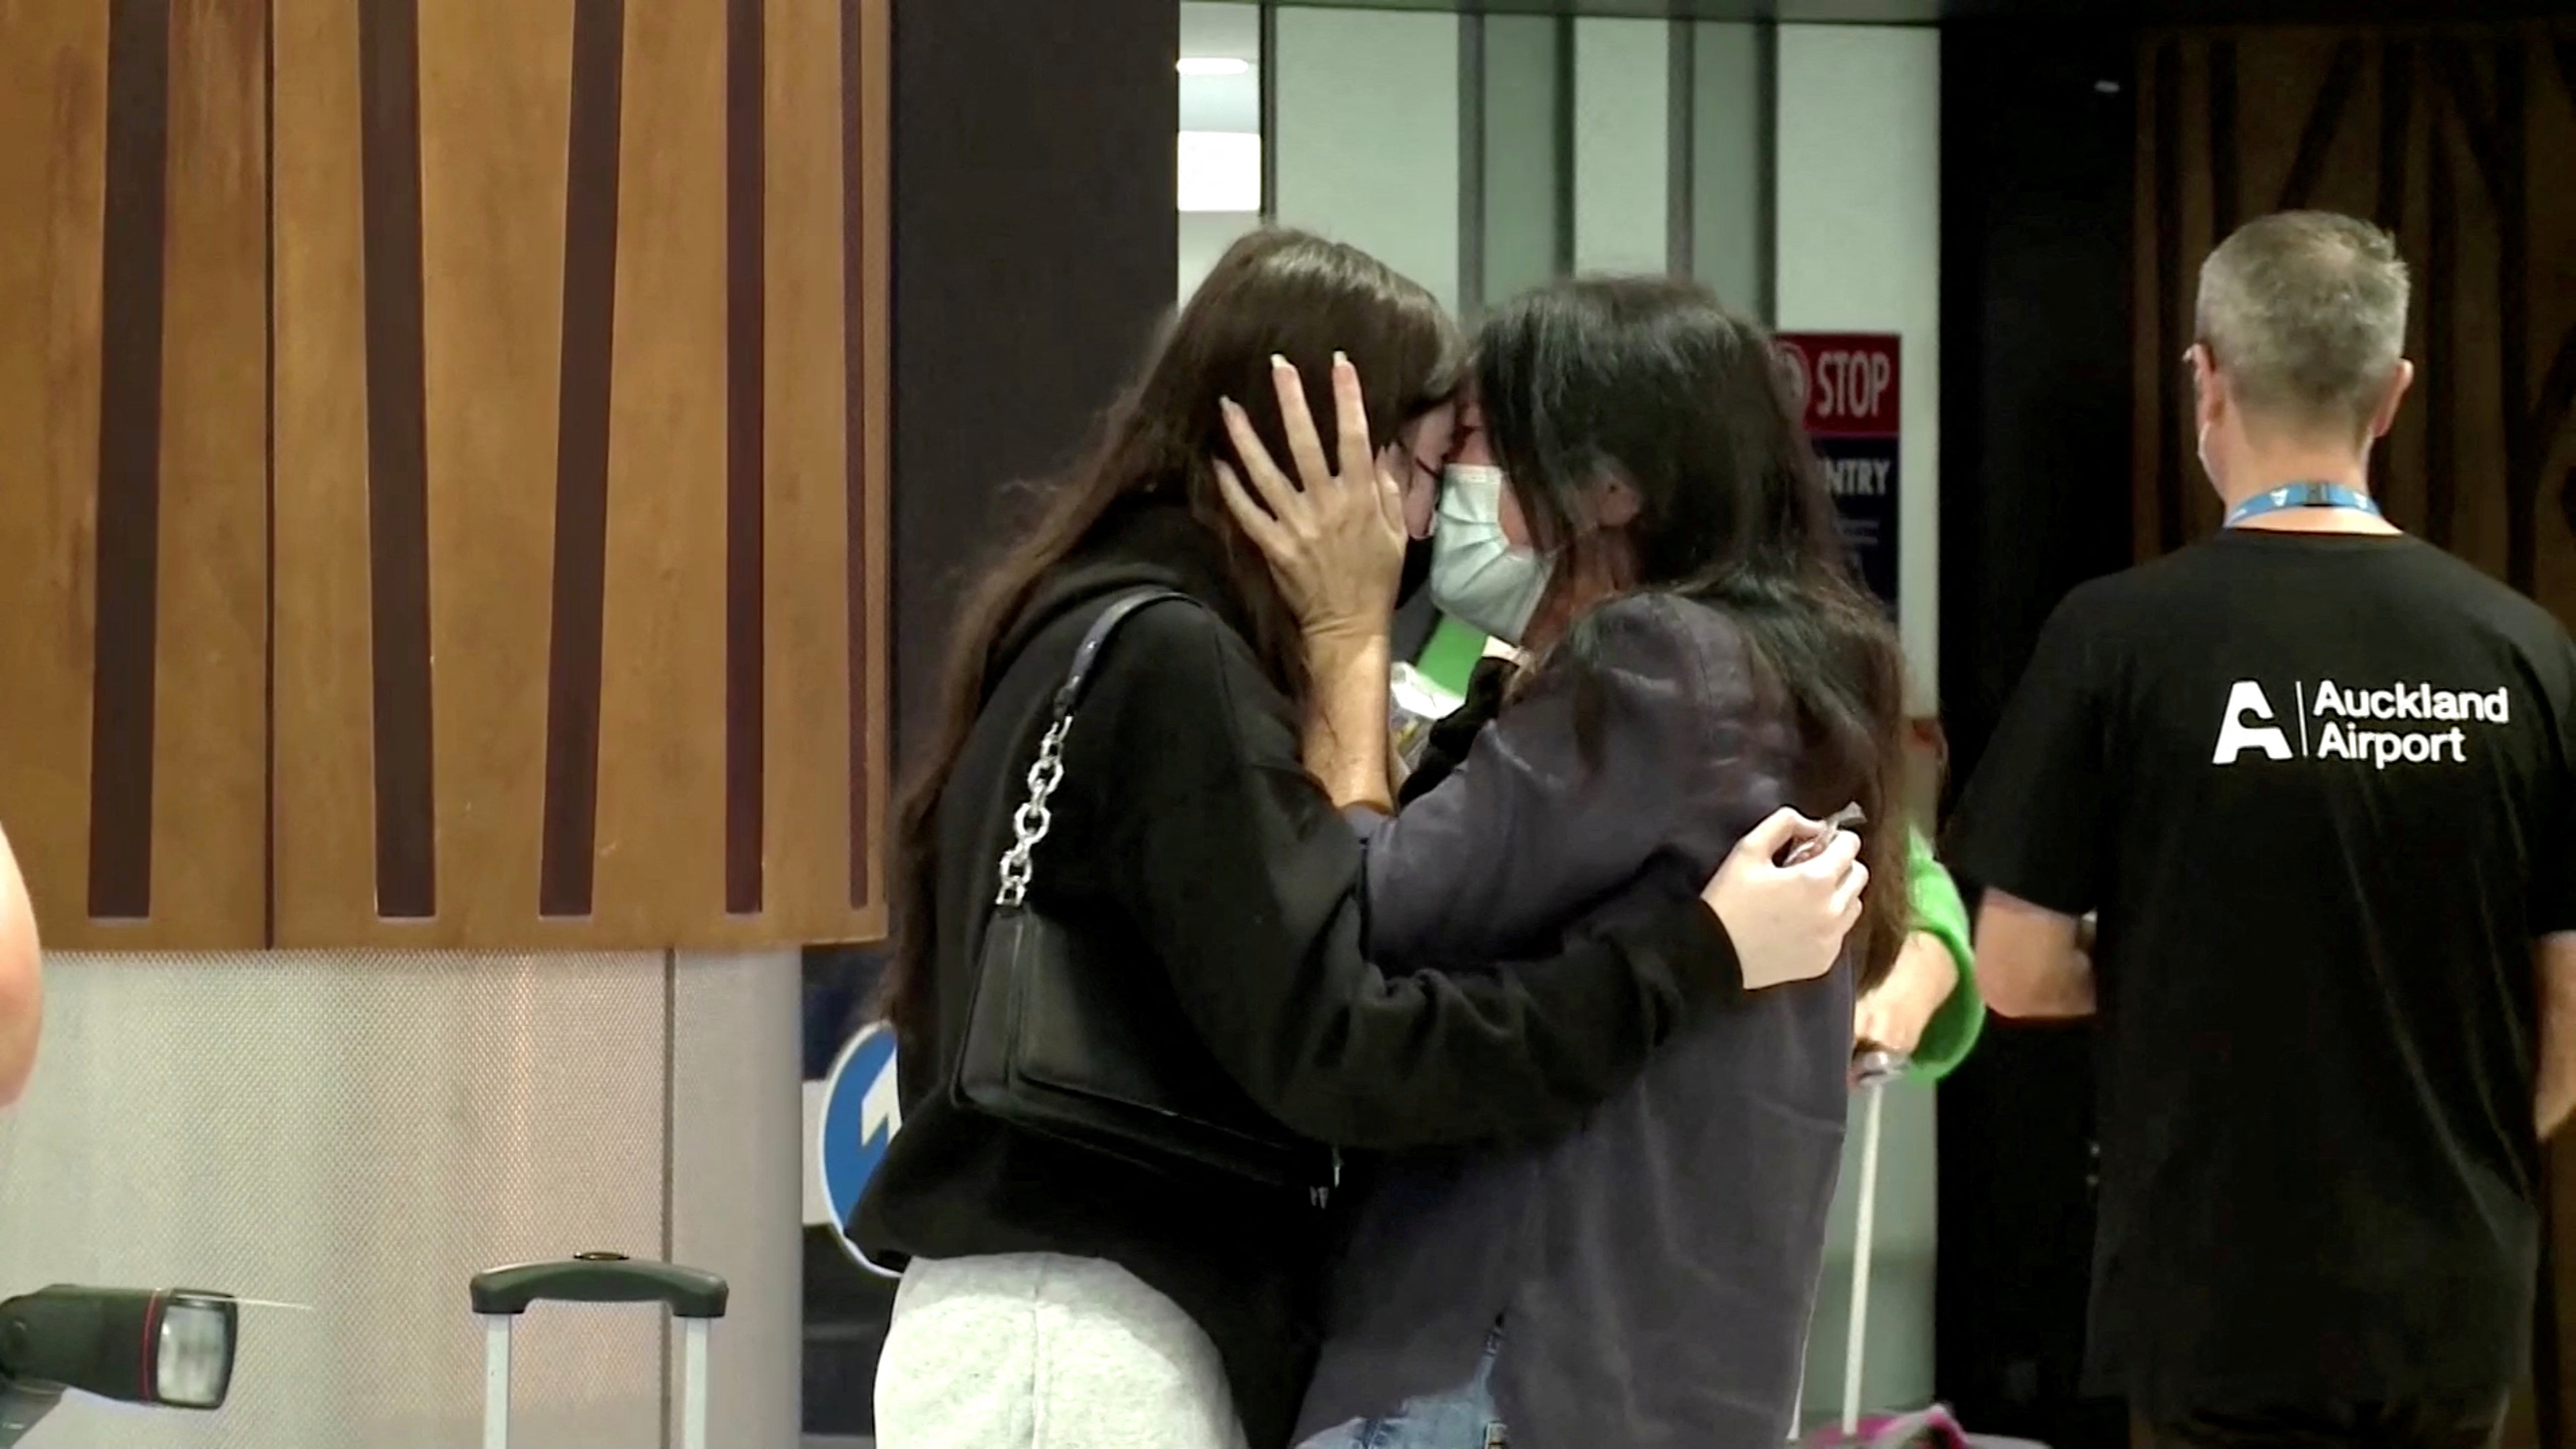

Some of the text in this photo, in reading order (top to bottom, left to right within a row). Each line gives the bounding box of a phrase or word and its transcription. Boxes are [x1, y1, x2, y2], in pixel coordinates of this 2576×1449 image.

[1816, 351, 1890, 417] STOP
[1818, 458, 1890, 495] NTRY
[2313, 680, 2509, 723] Auckland
[2317, 721, 2466, 769] Airport
